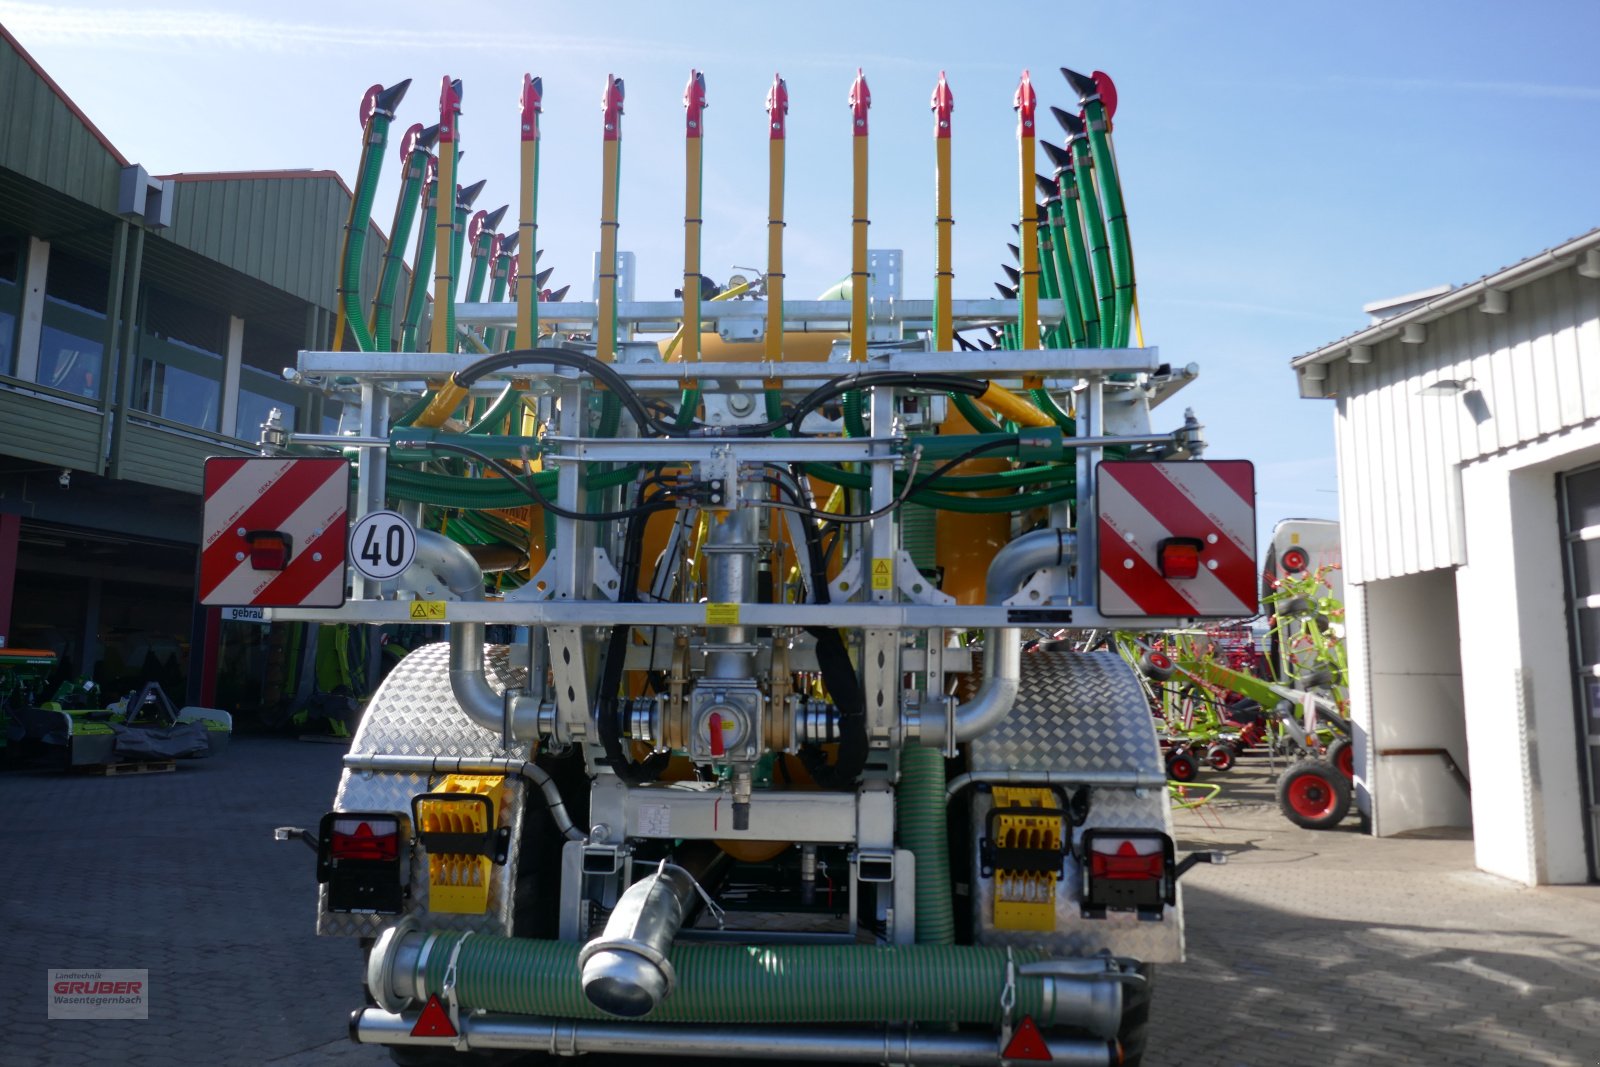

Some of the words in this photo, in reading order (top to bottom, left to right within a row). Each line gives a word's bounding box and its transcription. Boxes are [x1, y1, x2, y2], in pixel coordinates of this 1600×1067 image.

[257, 480, 272, 495] GEKA
[207, 530, 222, 545] GEKA
[361, 525, 405, 567] 40
